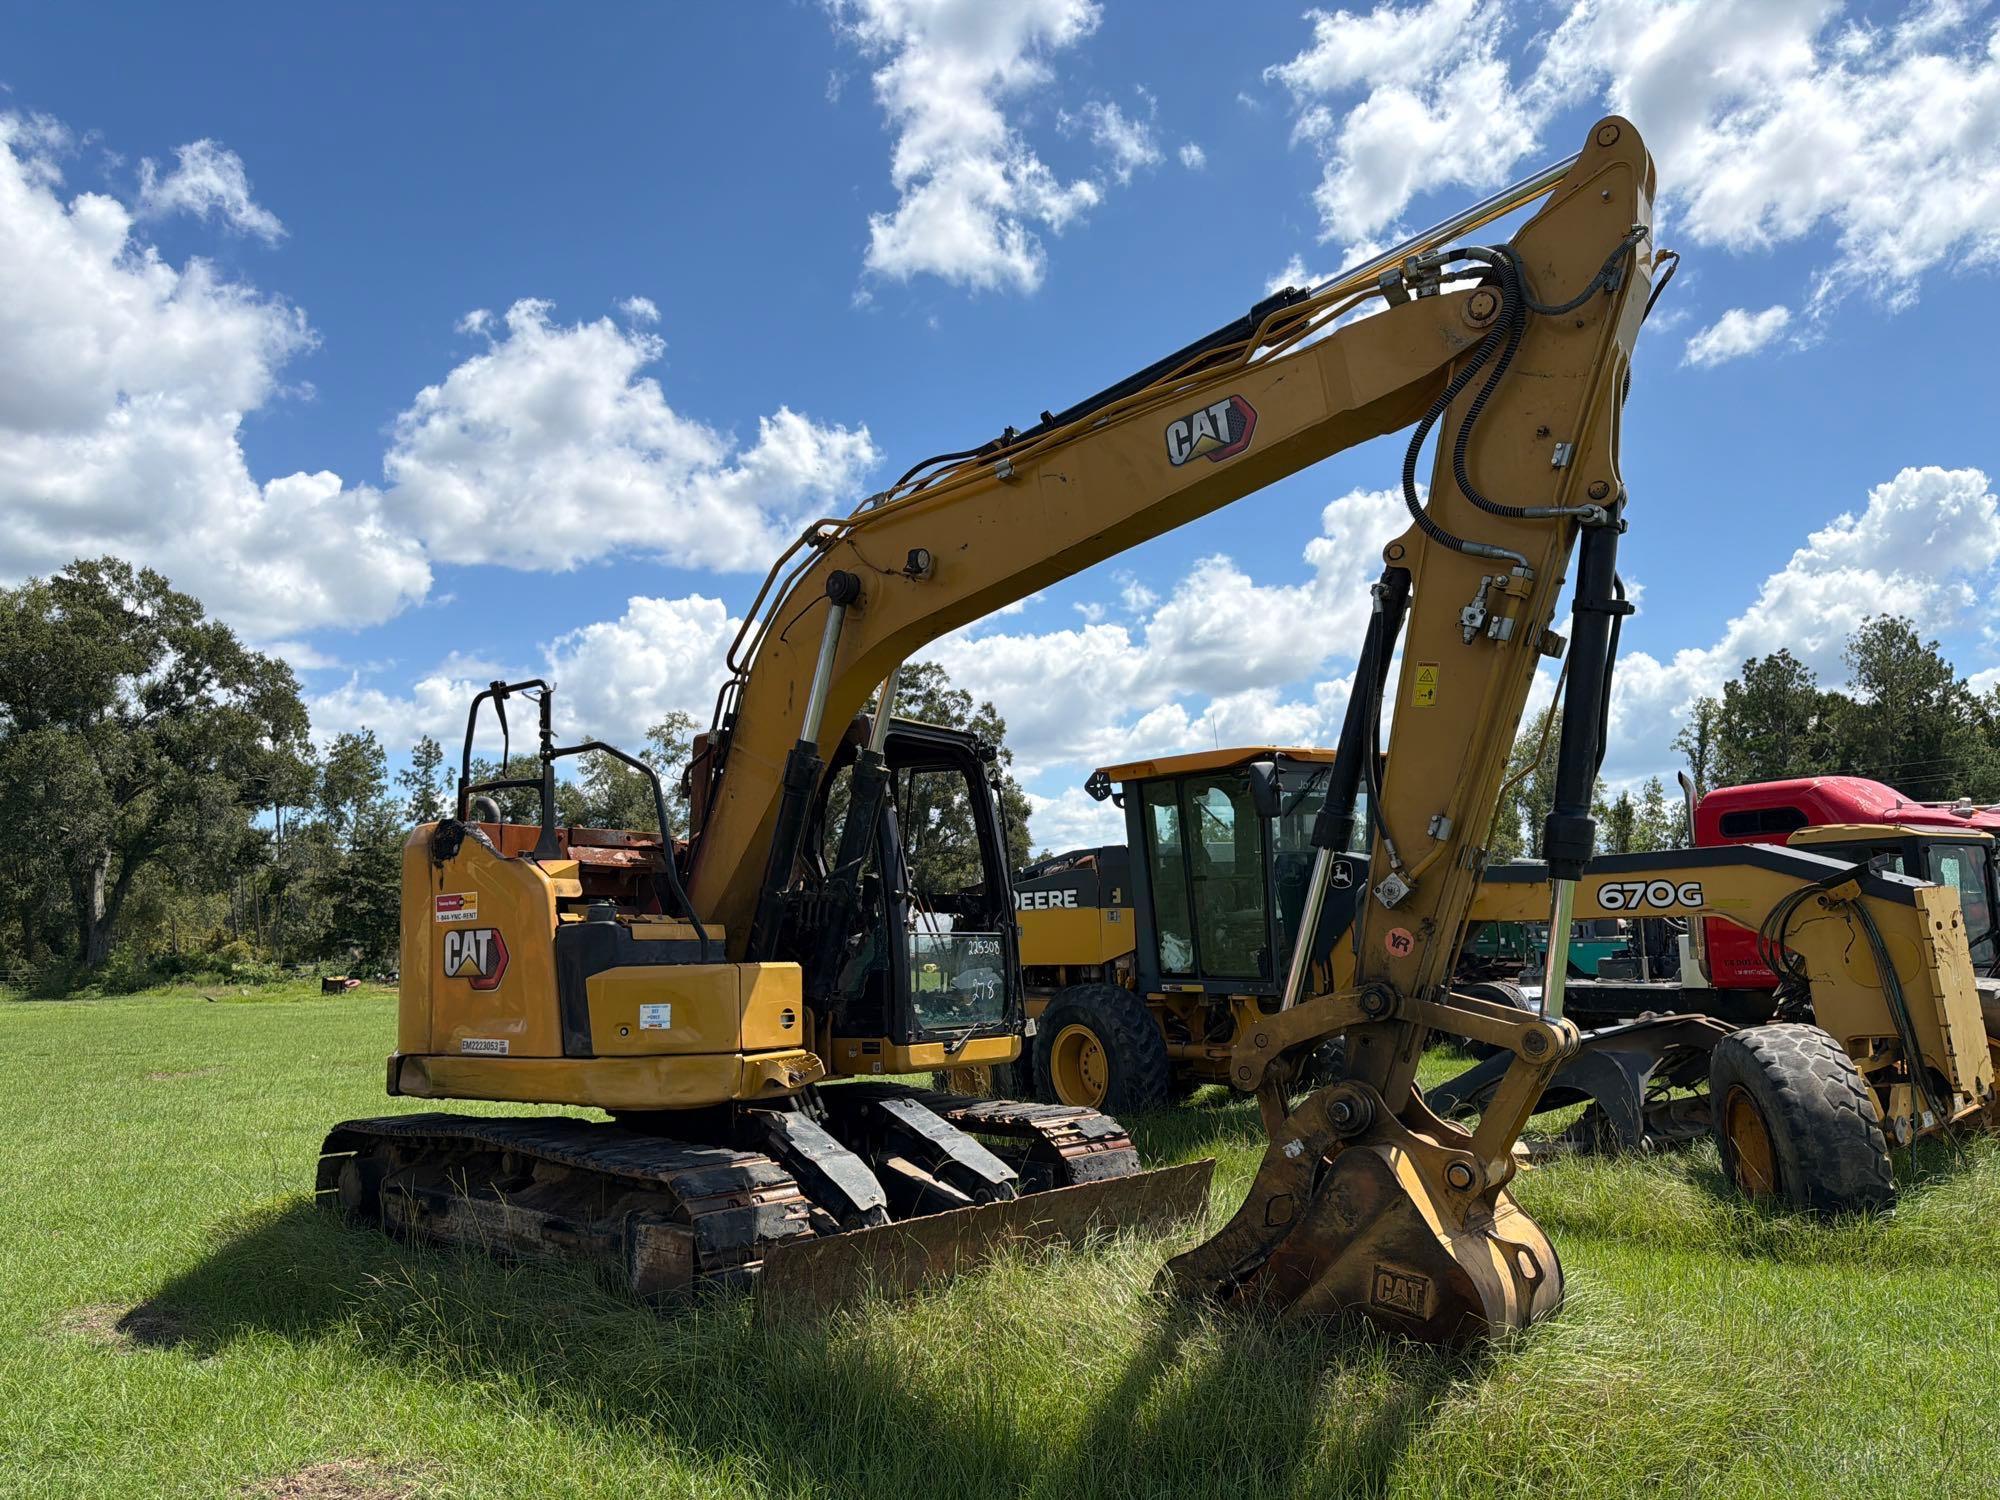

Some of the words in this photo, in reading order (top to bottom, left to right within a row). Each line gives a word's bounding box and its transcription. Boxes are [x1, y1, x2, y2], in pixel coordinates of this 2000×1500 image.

[1166, 399, 1231, 465] CAT
[1597, 879, 1704, 911] 670G
[444, 929, 492, 977] CAT
[968, 940, 1001, 956] 225308
[966, 978, 995, 1006] 278
[462, 1040, 499, 1051] EM2223053
[1377, 1274, 1423, 1312] CAT
